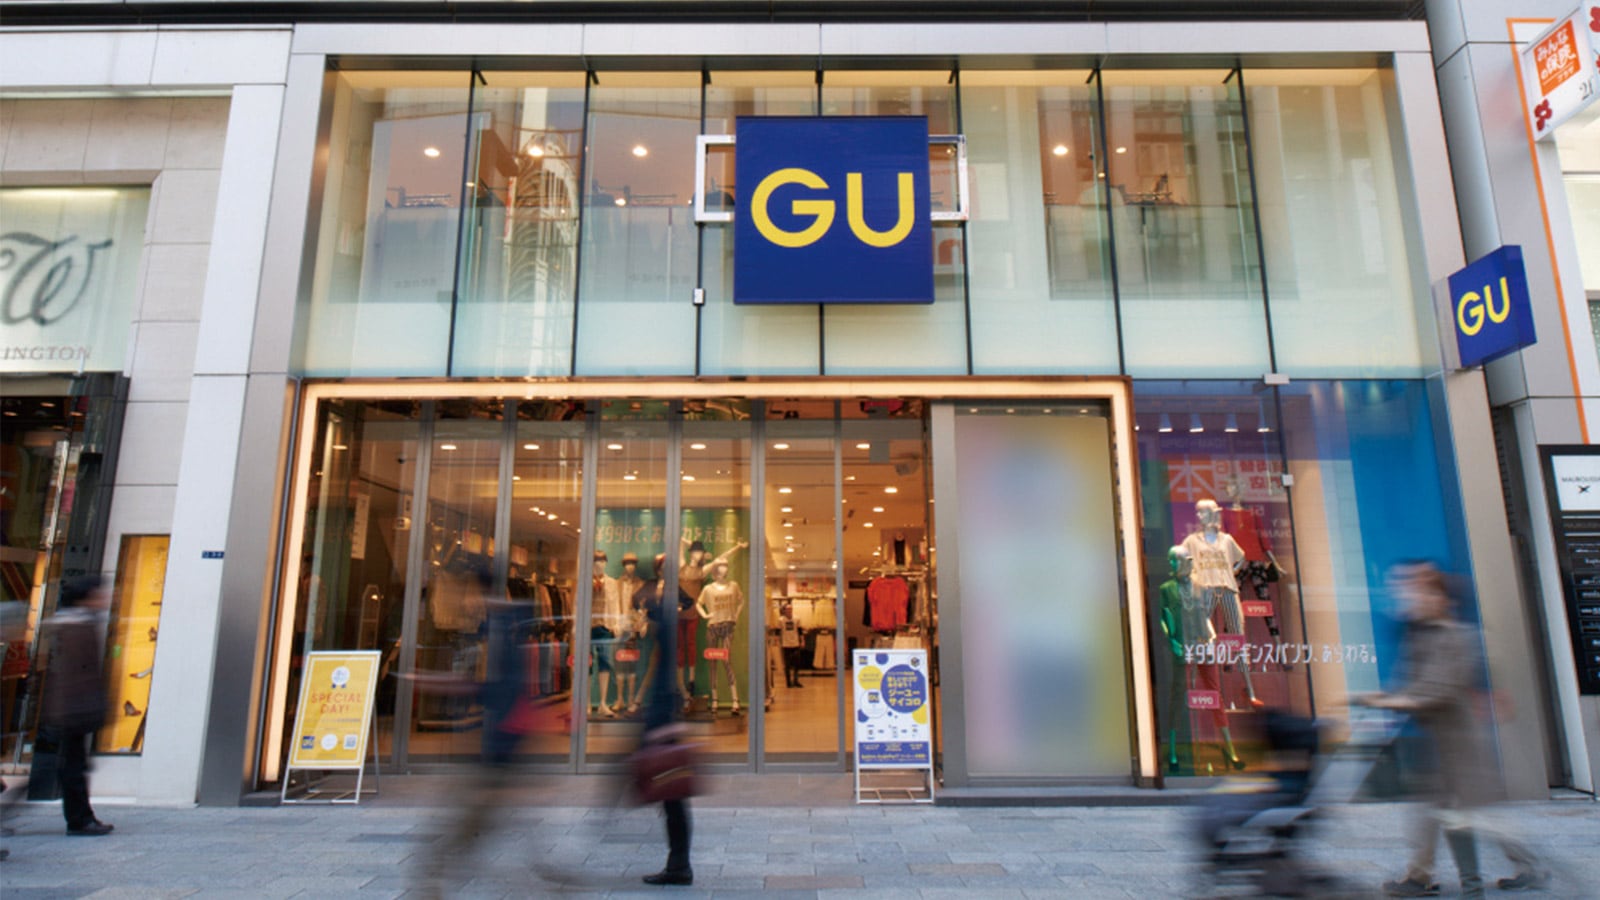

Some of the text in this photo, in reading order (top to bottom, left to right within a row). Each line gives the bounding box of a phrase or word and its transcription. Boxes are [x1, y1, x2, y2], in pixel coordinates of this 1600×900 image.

[751, 167, 915, 248] GU
[1457, 276, 1510, 336] GU
[888, 688, 920, 697] ジーユー
[311, 692, 362, 704] SPECIAL
[888, 697, 922, 706] サイコロ
[1191, 696, 1214, 705] ¥990
